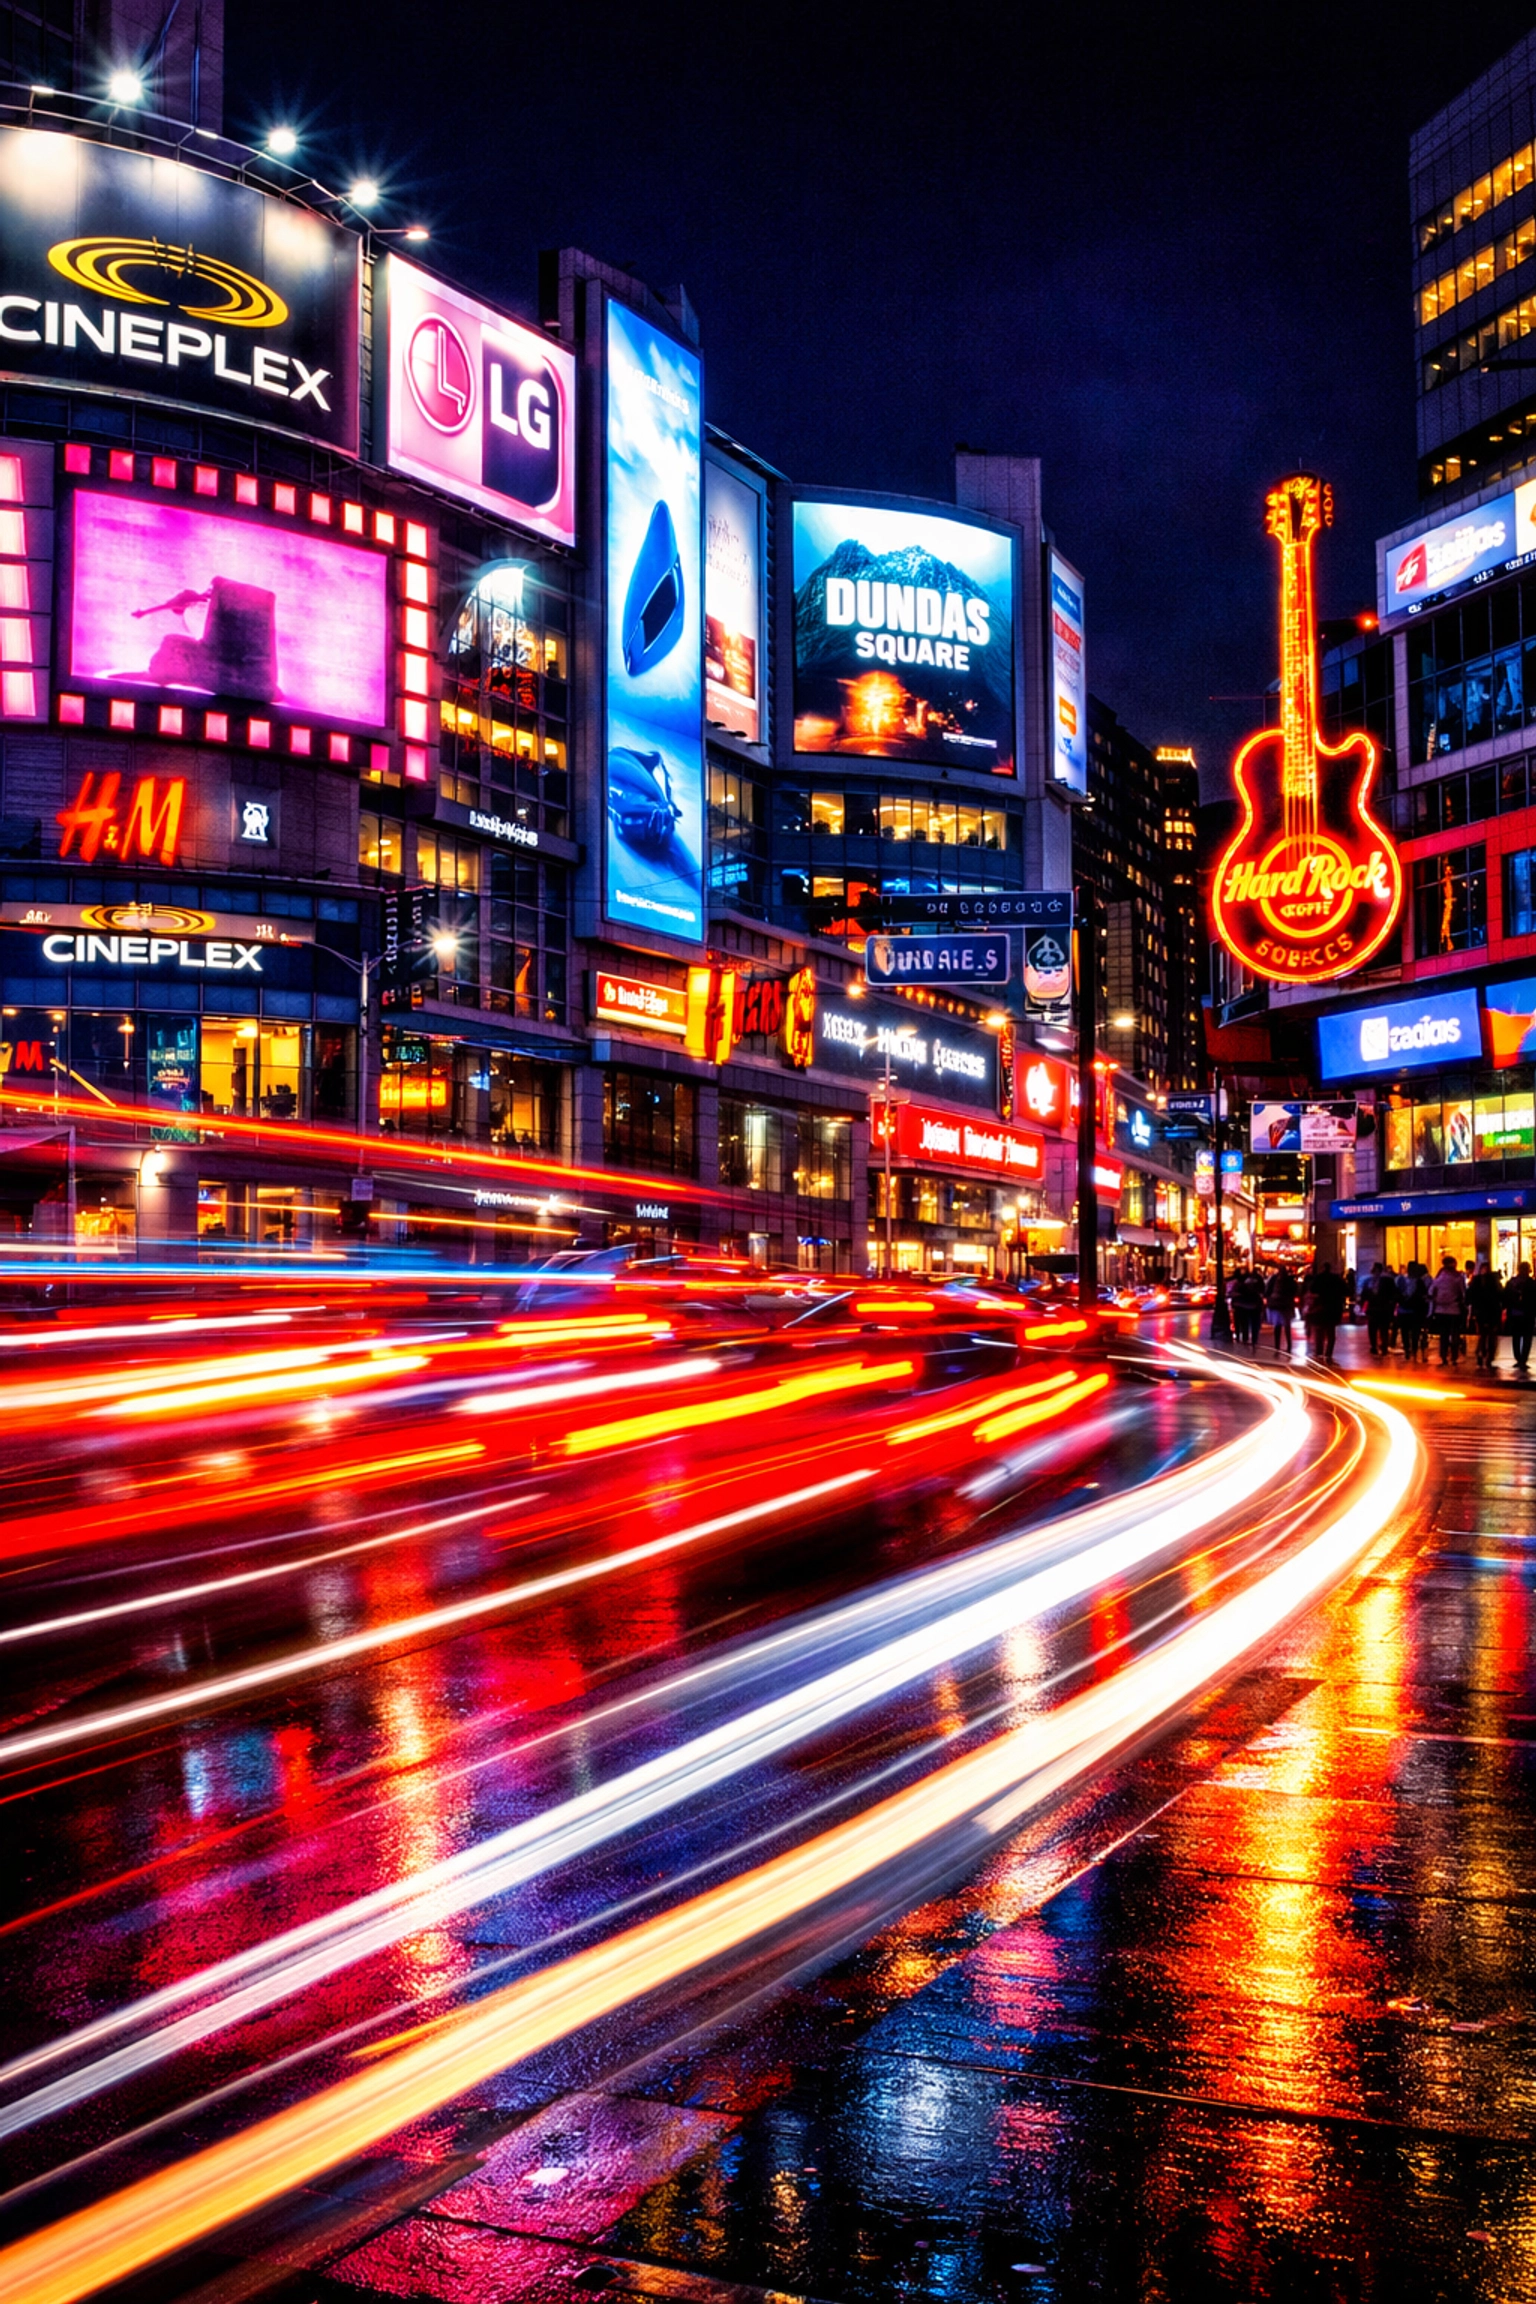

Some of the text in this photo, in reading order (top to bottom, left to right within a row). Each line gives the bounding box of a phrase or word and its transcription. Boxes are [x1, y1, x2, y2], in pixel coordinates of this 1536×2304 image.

[0, 295, 332, 412] CINEPLEX
[490, 362, 551, 451] LG
[826, 577, 990, 646] DUNDAS
[855, 631, 970, 671] SQUARE
[1223, 851, 1391, 903] Hard Rock
[42, 934, 263, 972] CINEPLEX
